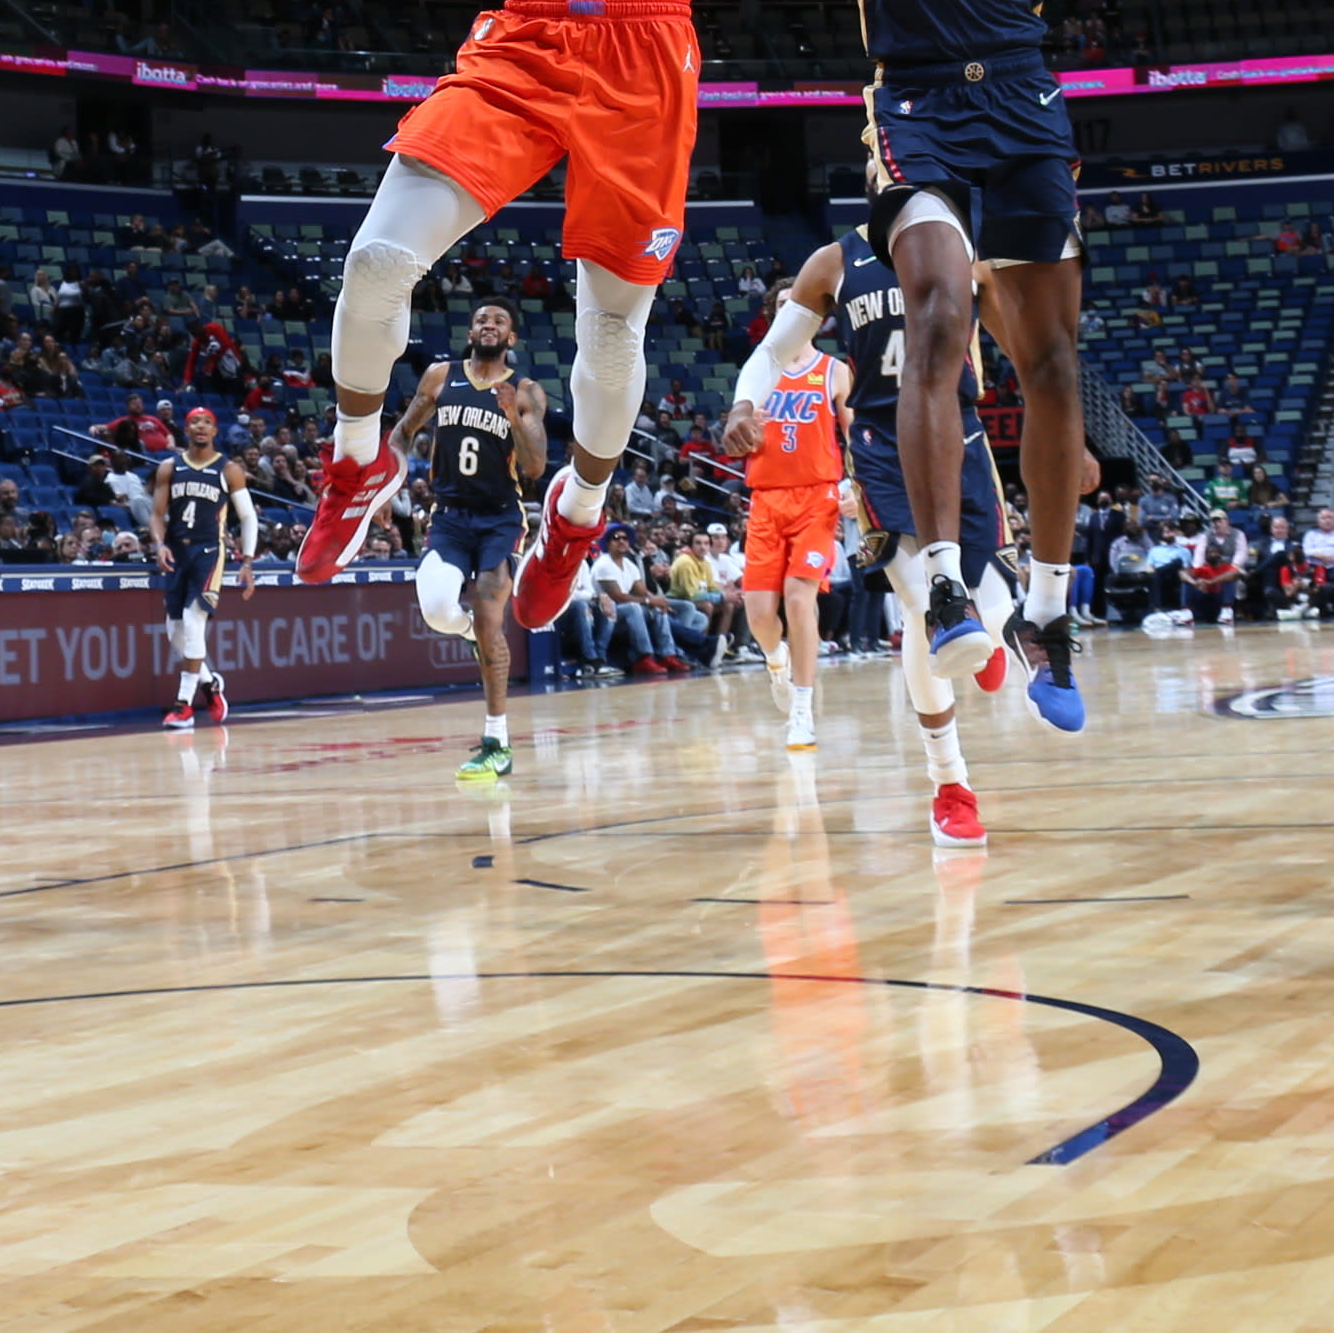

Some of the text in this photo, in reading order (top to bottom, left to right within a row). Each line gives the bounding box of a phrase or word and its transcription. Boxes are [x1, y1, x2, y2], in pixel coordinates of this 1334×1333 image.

[136, 62, 188, 84] ibotta
[1147, 70, 1208, 89] ibotta
[1151, 158, 1285, 178] BETRIVERS
[845, 289, 884, 331] NEW
[767, 391, 823, 424] OKC
[437, 406, 512, 441] NEW ORLEANS
[781, 425, 797, 452] 3
[458, 436, 480, 476] 6
[186, 483, 220, 502] ORLEANS
[182, 501, 196, 528] 4
[55, 624, 137, 681] YOU
[144, 619, 260, 676] TEN
[269, 614, 351, 667] CARE
[357, 613, 394, 660] OF
